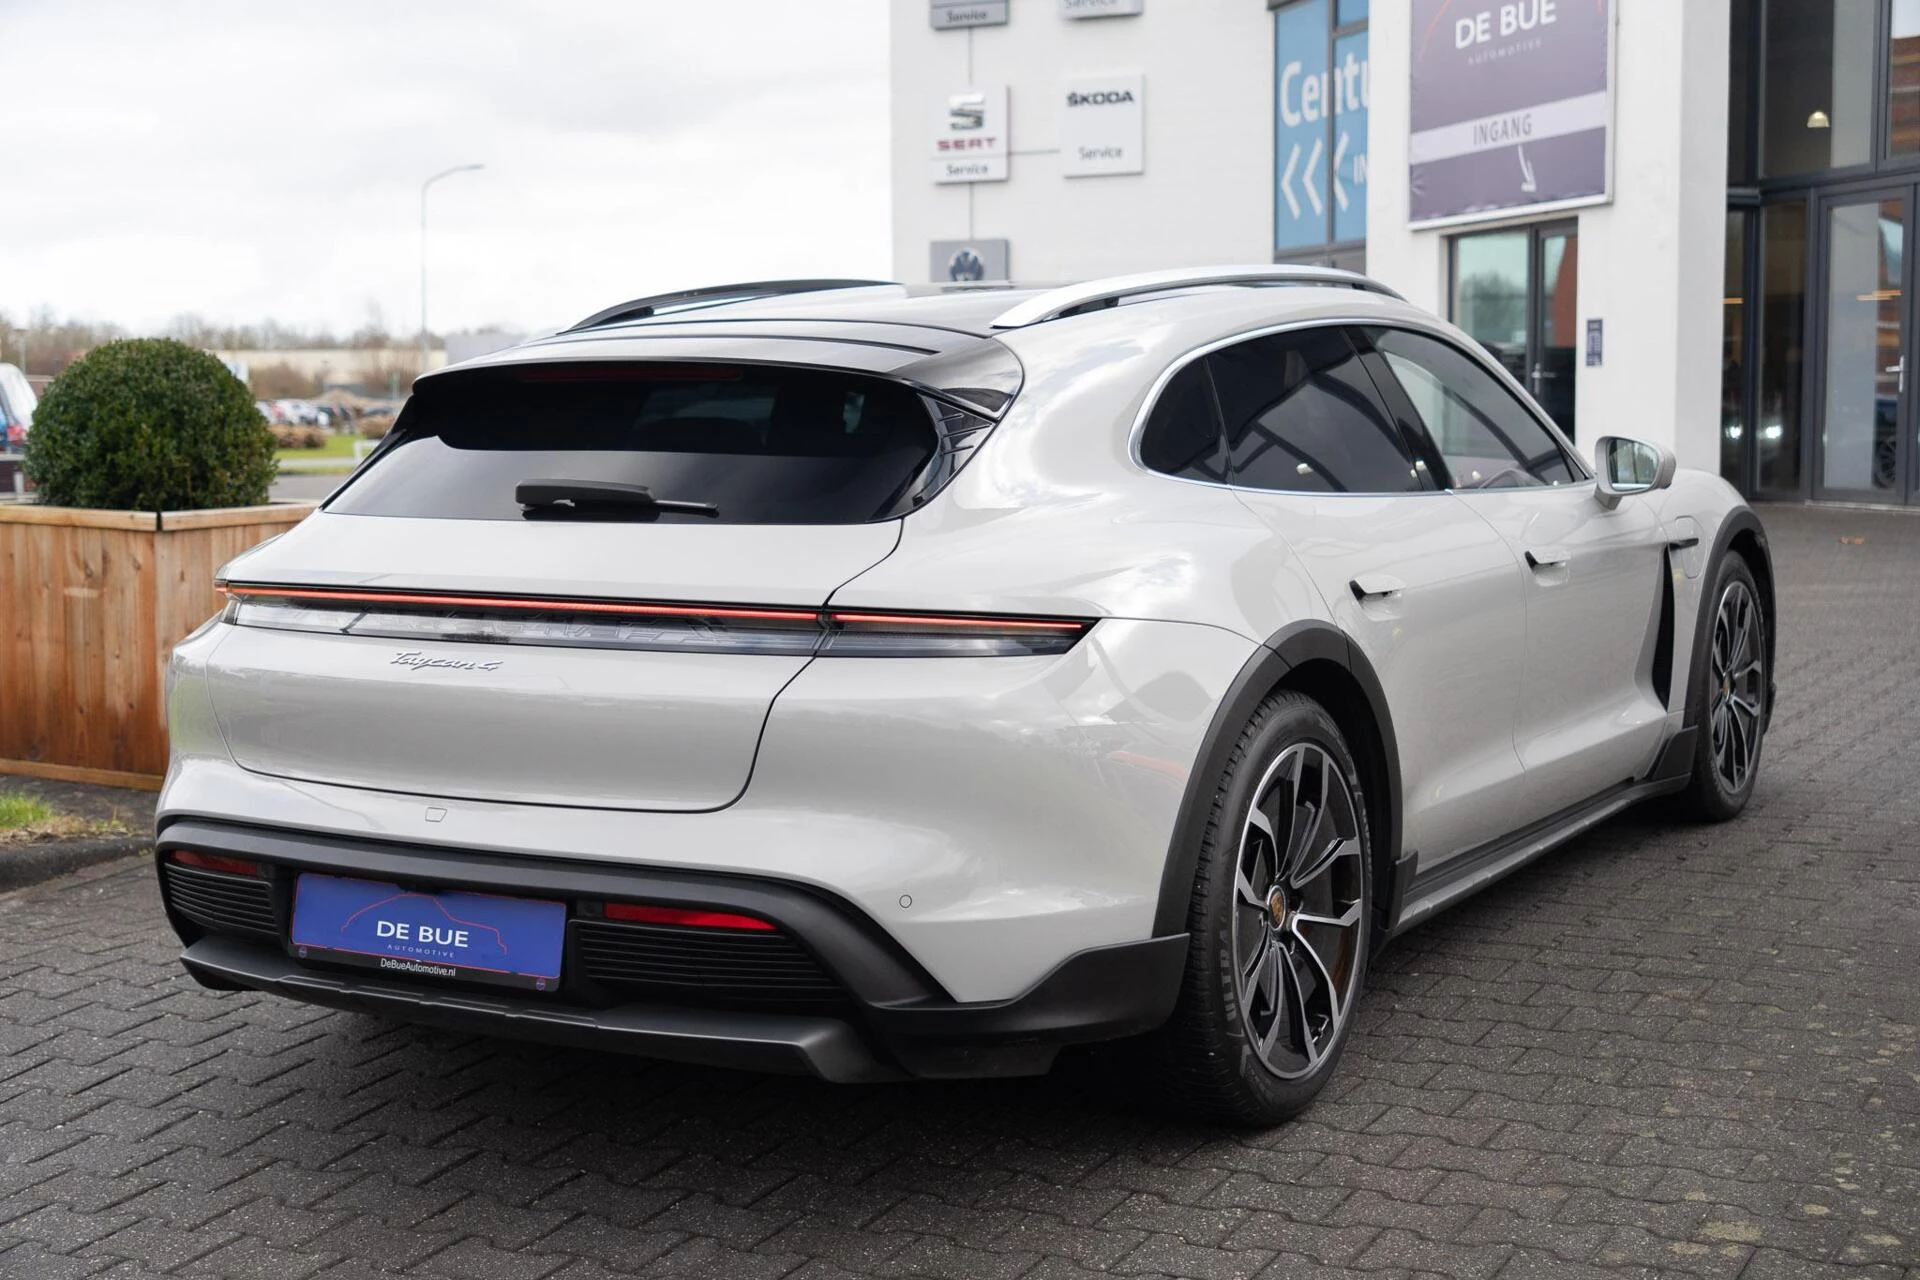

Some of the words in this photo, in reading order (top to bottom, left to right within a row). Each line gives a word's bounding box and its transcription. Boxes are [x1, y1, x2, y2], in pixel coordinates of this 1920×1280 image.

[1454, 10, 1492, 49] DE
[1499, 0, 1558, 37] BUE
[1472, 112, 1533, 146] INGANG
[937, 136, 997, 151] SEAT
[1079, 146, 1122, 160] Service
[946, 163, 988, 178] Service
[390, 651, 477, 671] Taycan
[376, 920, 410, 940] DE
[418, 925, 469, 948] BUE
[386, 944, 455, 958] AUTOMOTIVE
[380, 958, 456, 977] DeBueAutomotive.nl
